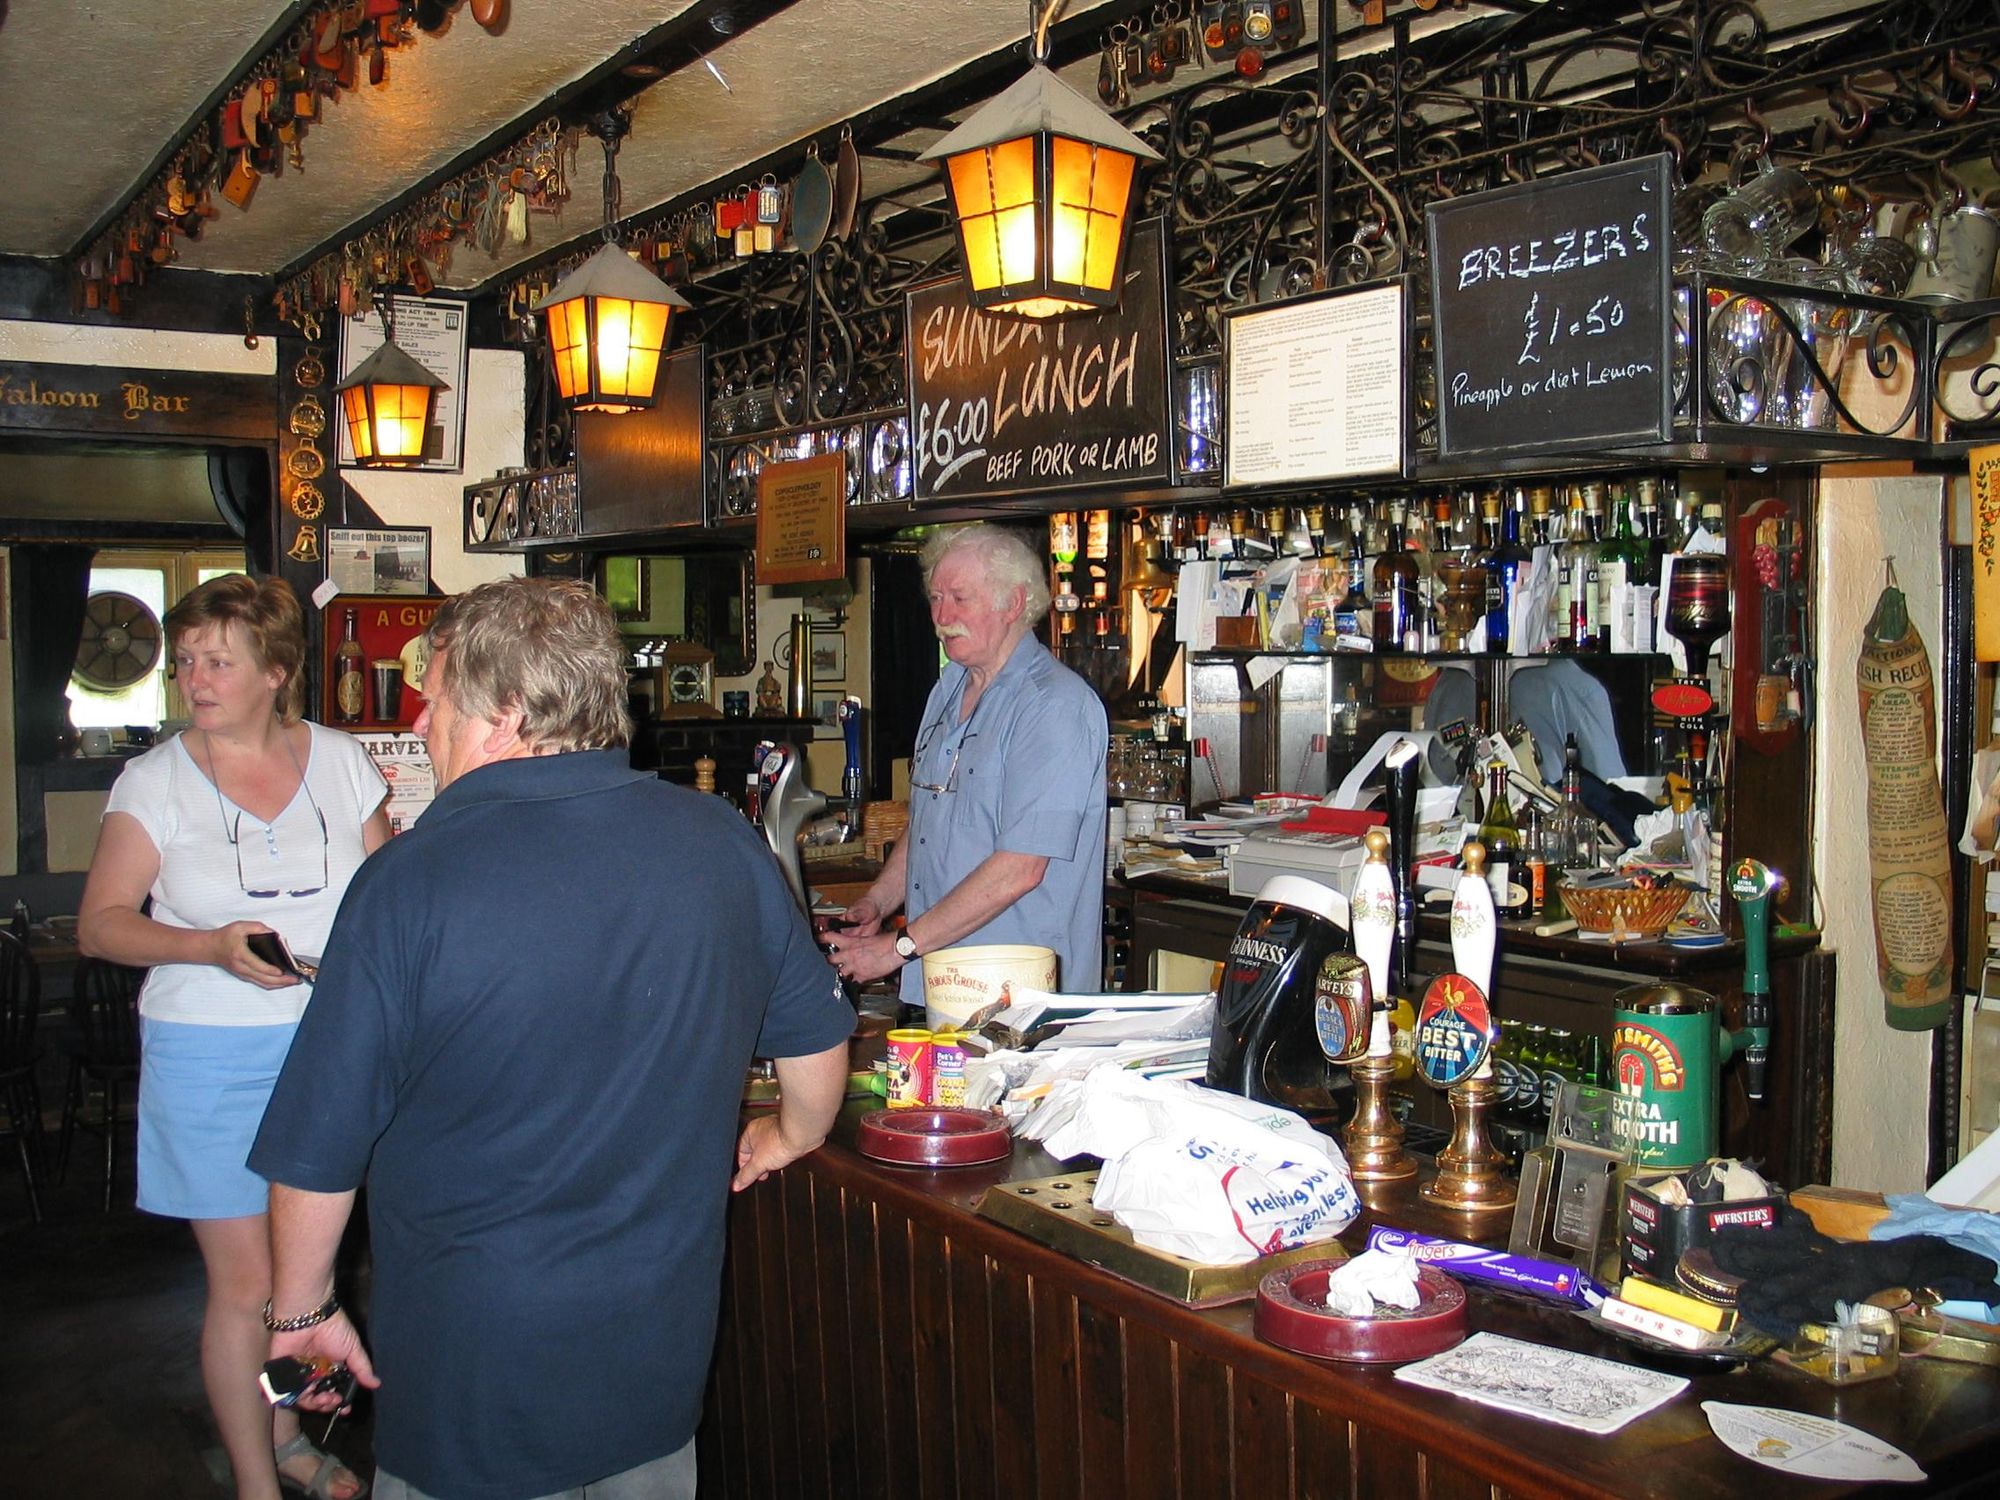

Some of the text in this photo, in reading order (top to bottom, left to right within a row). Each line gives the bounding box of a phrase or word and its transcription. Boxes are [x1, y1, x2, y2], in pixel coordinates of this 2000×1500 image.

[1458, 213, 1650, 291] BREEZERS
[1517, 291, 1624, 365] £1.50
[992, 331, 1139, 439] LUNCH
[1451, 361, 1653, 412] Pineapple or diet Lemon
[120, 381, 192, 421] Bar
[916, 397, 989, 482] £6.00
[986, 433, 1159, 483] BEEF PORK OR LAMB
[330, 531, 425, 543] Sniff out this top boozer
[376, 609, 390, 627] A
[1679, 722, 1705, 730] COLA
[1732, 884, 1758, 894] SMOOTH
[1230, 935, 1288, 966] GUINNESS
[953, 973, 990, 993] GROUSE
[1429, 1016, 1466, 1031] COURAGE
[1421, 1026, 1478, 1051] BEST
[1424, 1045, 1462, 1062] BITTER
[1624, 1027, 1685, 1087] SMITH'S
[1612, 1096, 1662, 1121] EXTRA
[1713, 1208, 1769, 1227] WEBSTER'S
[1407, 1239, 1456, 1262] fingers
